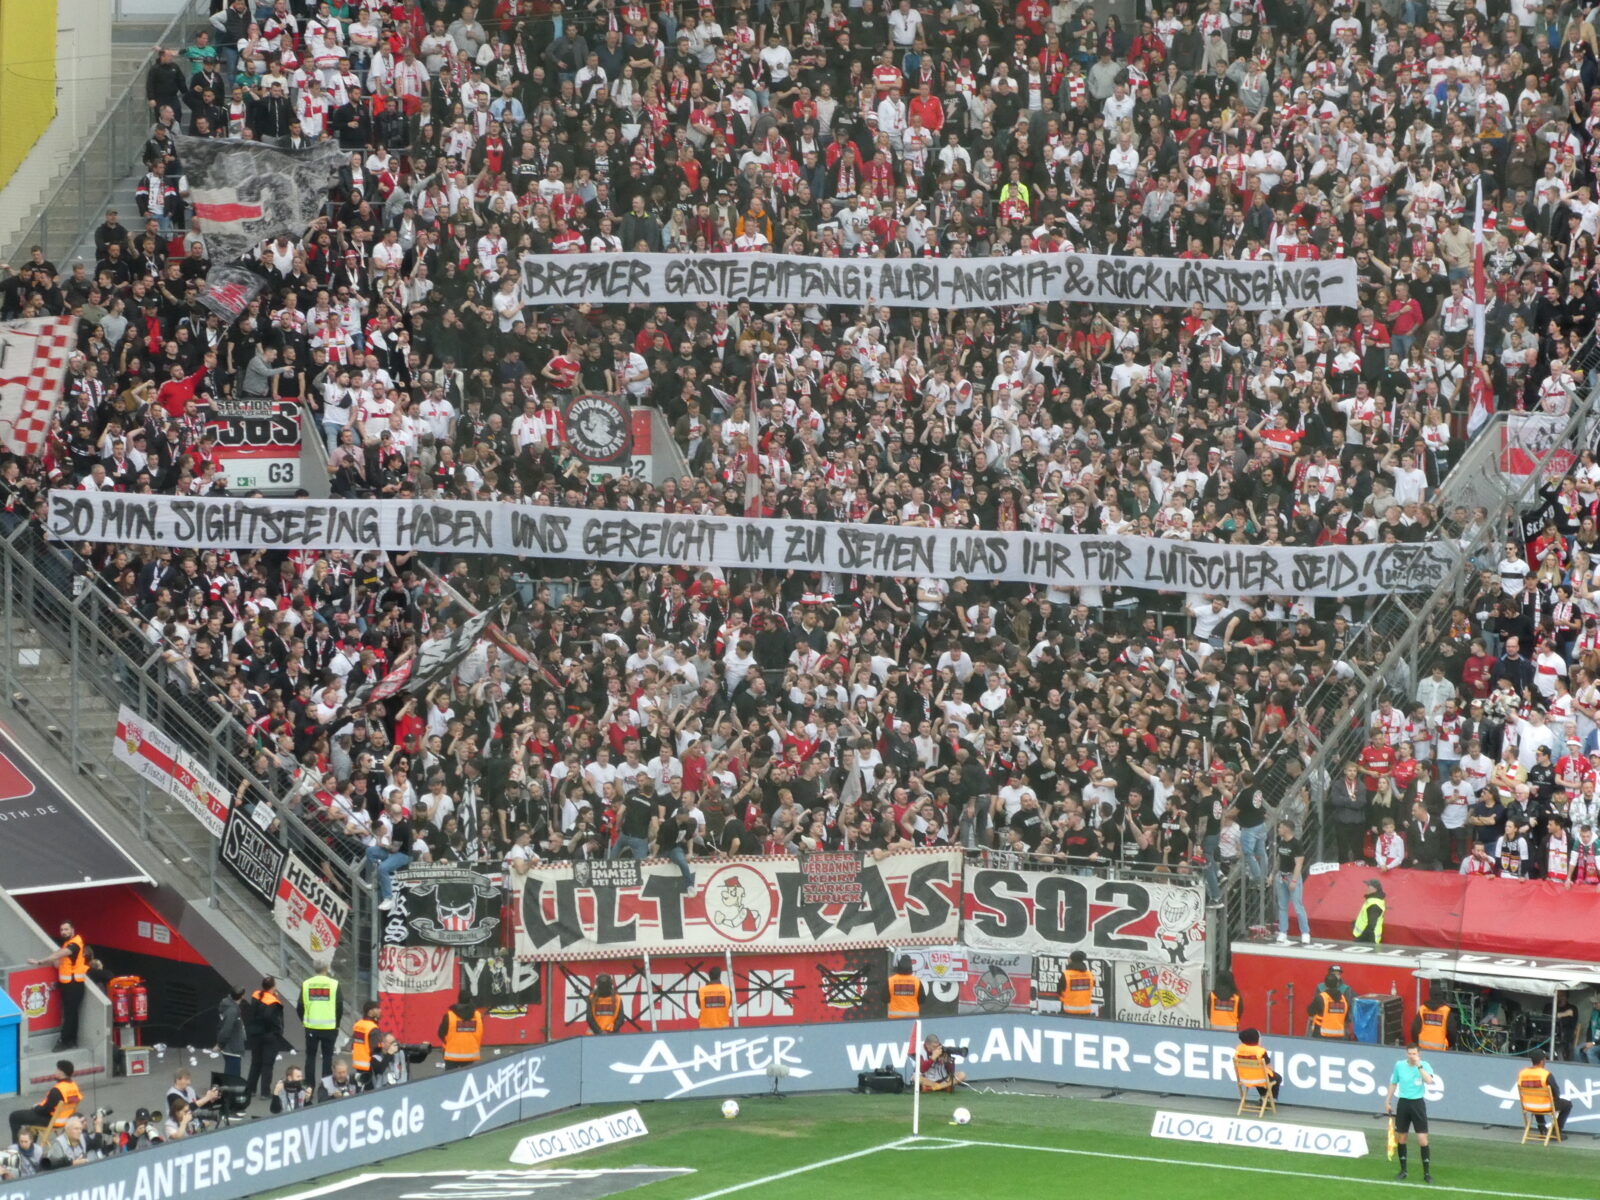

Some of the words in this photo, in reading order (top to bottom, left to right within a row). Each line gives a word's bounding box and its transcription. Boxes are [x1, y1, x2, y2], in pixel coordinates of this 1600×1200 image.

[523, 258, 652, 299] BREMER
[879, 259, 1061, 305] ALIBI-ANGRIFF
[1063, 256, 1097, 298] &
[567, 428, 627, 458] STUTTGART
[268, 463, 294, 483] G3
[52, 496, 95, 537] 30
[101, 498, 164, 540] MIN.
[170, 500, 381, 547] SIGHTSEEING
[397, 505, 493, 548] HABEN
[511, 508, 571, 553] UNS
[582, 517, 727, 561] GEREICHT
[737, 523, 773, 564] UM
[784, 525, 826, 566] ZU
[838, 527, 936, 573] SEHEN
[950, 535, 1008, 574] WAS
[1022, 538, 1075, 579] IHR
[1080, 540, 1133, 583] FÜR
[1145, 545, 1284, 591] LUTSCHER
[1292, 550, 1376, 592] SEID!
[181, 771, 191, 785] 20
[211, 801, 222, 814] 17
[591, 860, 607, 869] DU
[611, 860, 636, 869] BIST
[802, 861, 861, 874] VERBANNTE
[808, 853, 855, 864] JEDER
[591, 869, 637, 879] IMMER
[593, 878, 609, 886] BEI
[612, 878, 638, 886] UNS!
[808, 873, 857, 883] KEHRT
[287, 861, 344, 927] HESSEN
[1038, 956, 1102, 976] ULTS
[385, 973, 438, 992] Stuttgart
[1117, 1008, 1201, 1028] Gundelsheim
[614, 1036, 808, 1094] ANTER
[1158, 1114, 1216, 1140] iLOQ
[1225, 1120, 1283, 1147] iLOQ
[1294, 1127, 1353, 1154] iLOQ
